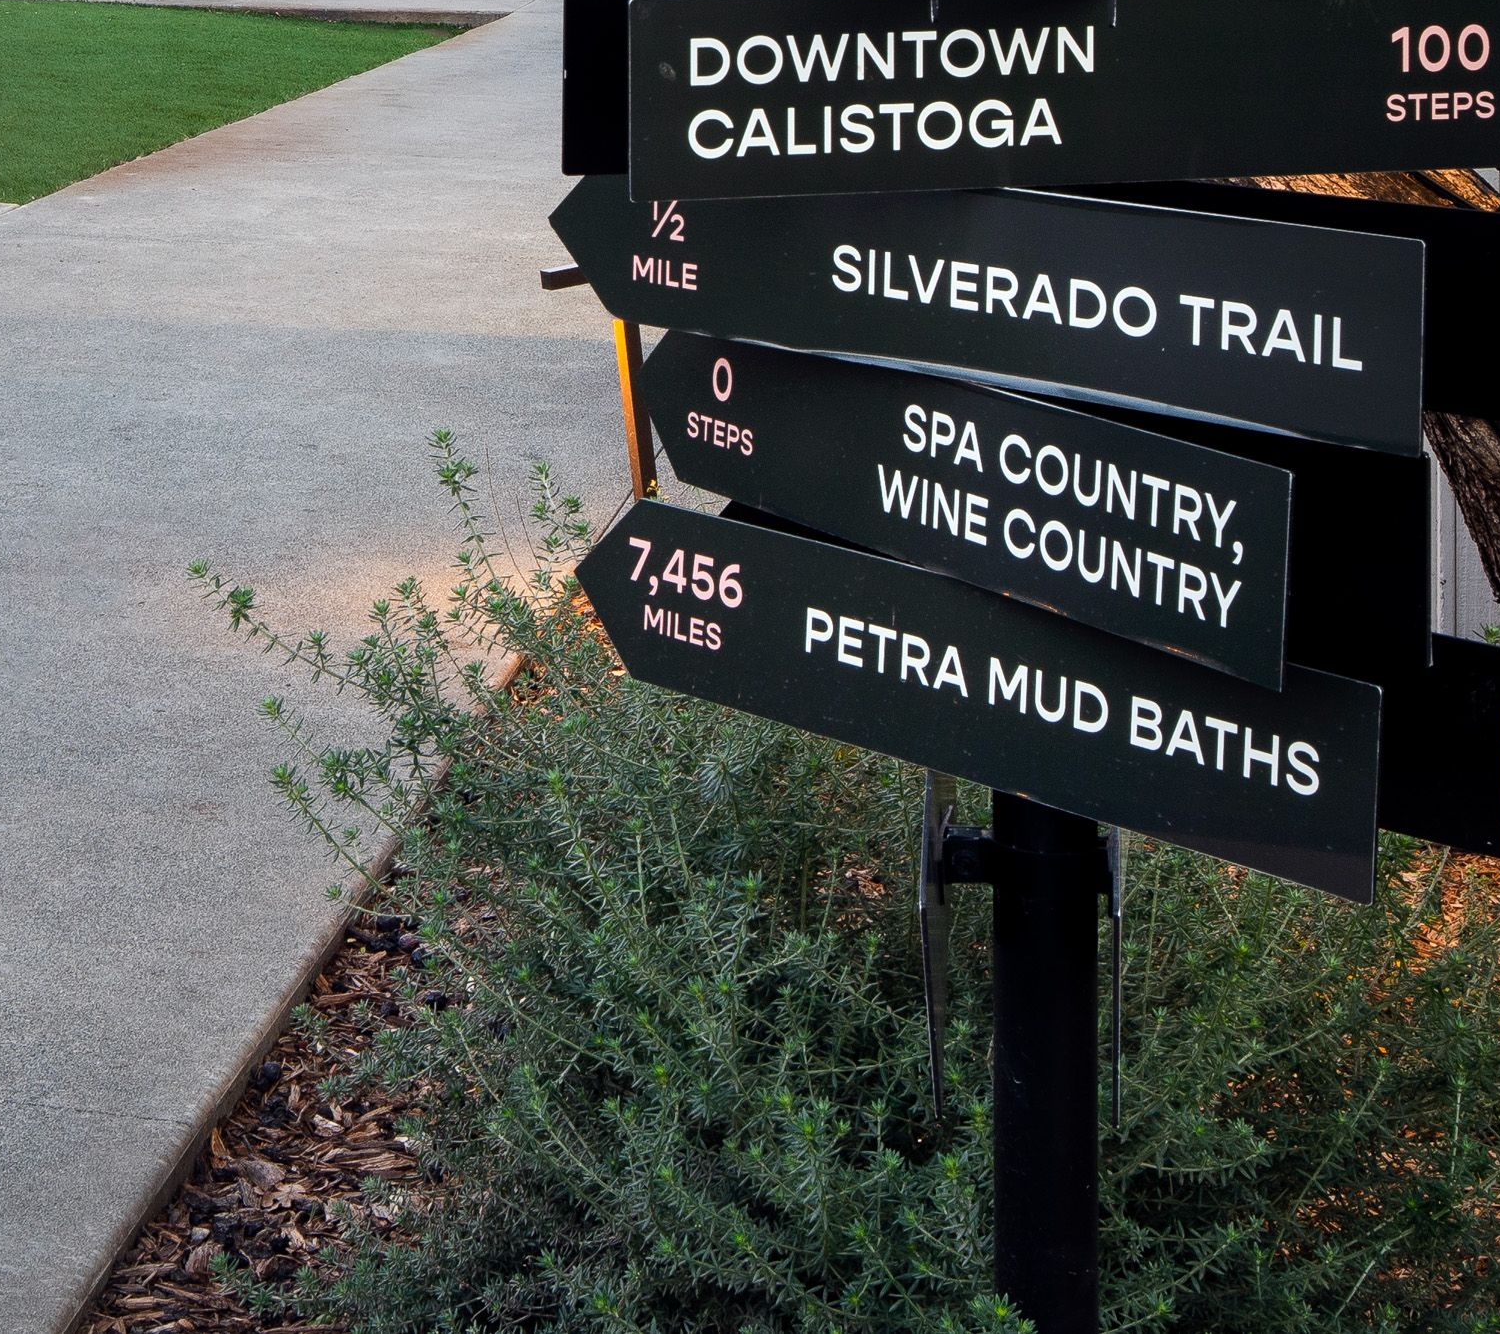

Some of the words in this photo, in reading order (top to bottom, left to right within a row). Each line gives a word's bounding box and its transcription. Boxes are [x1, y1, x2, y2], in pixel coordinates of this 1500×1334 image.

[690, 26, 1094, 86] DOWNTOWN
[1392, 24, 1489, 72] 100
[688, 99, 1062, 159] CALISTOGA
[1387, 91, 1494, 121] STEPS
[633, 255, 697, 290] MILE
[832, 245, 1157, 337] SILVERADO
[1180, 295, 1362, 371] TRAIL
[713, 358, 732, 401] 0
[687, 412, 752, 455] STEPS
[903, 405, 983, 472] SPA
[1000, 435, 1243, 559] COUNTRY,
[630, 537, 742, 608] 7,456
[878, 464, 988, 545] WINE
[1004, 509, 1241, 627] COUNTRY
[644, 605, 721, 650] MILES
[806, 607, 968, 697] PETRA
[989, 657, 1108, 732] MUD
[1130, 696, 1319, 795] BATHS
